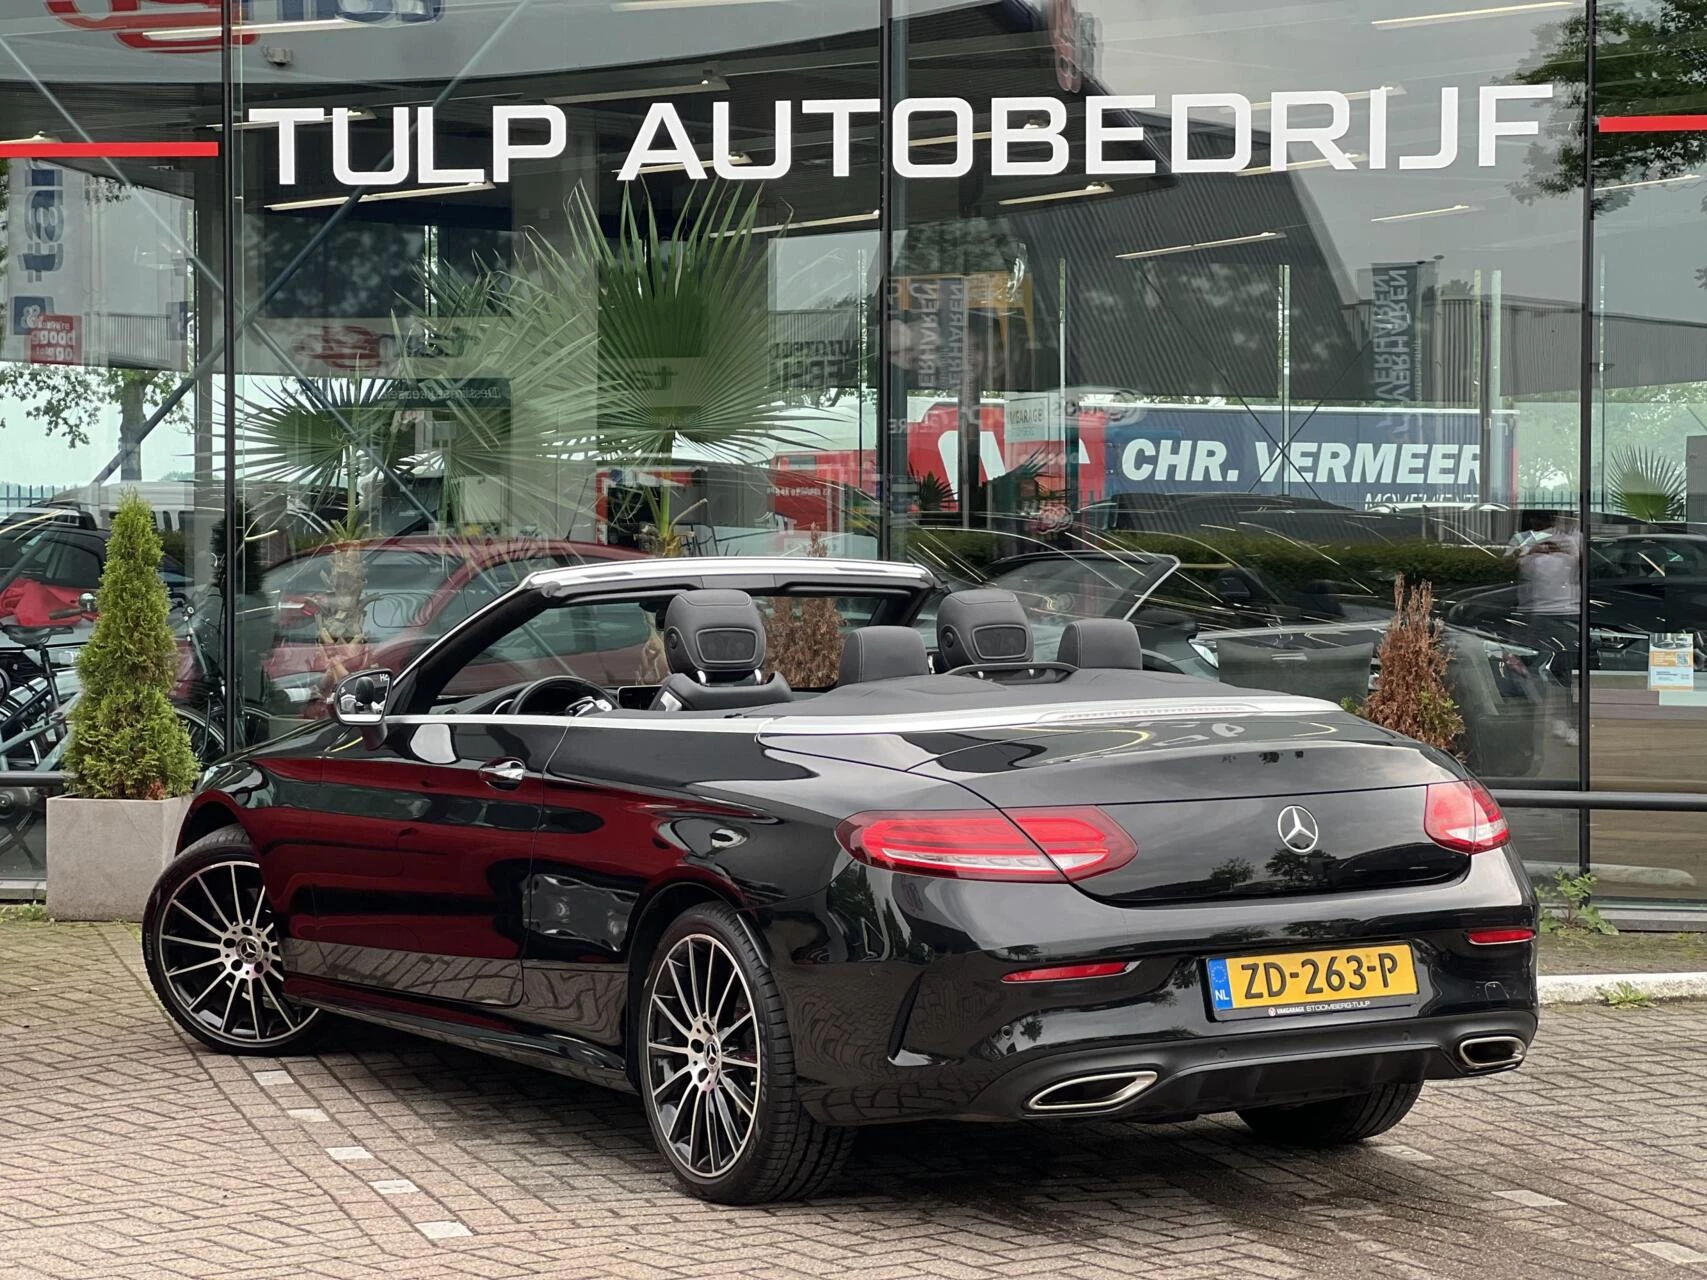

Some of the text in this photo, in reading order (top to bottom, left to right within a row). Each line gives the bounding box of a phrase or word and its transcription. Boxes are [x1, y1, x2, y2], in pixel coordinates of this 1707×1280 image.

[248, 84, 1554, 186] TULP AUTOBEDRIJF
[1120, 438, 1481, 485] CHR. VERMEER
[1215, 990, 1230, 1001] NL
[1241, 952, 1398, 1000] ZD-263-P
